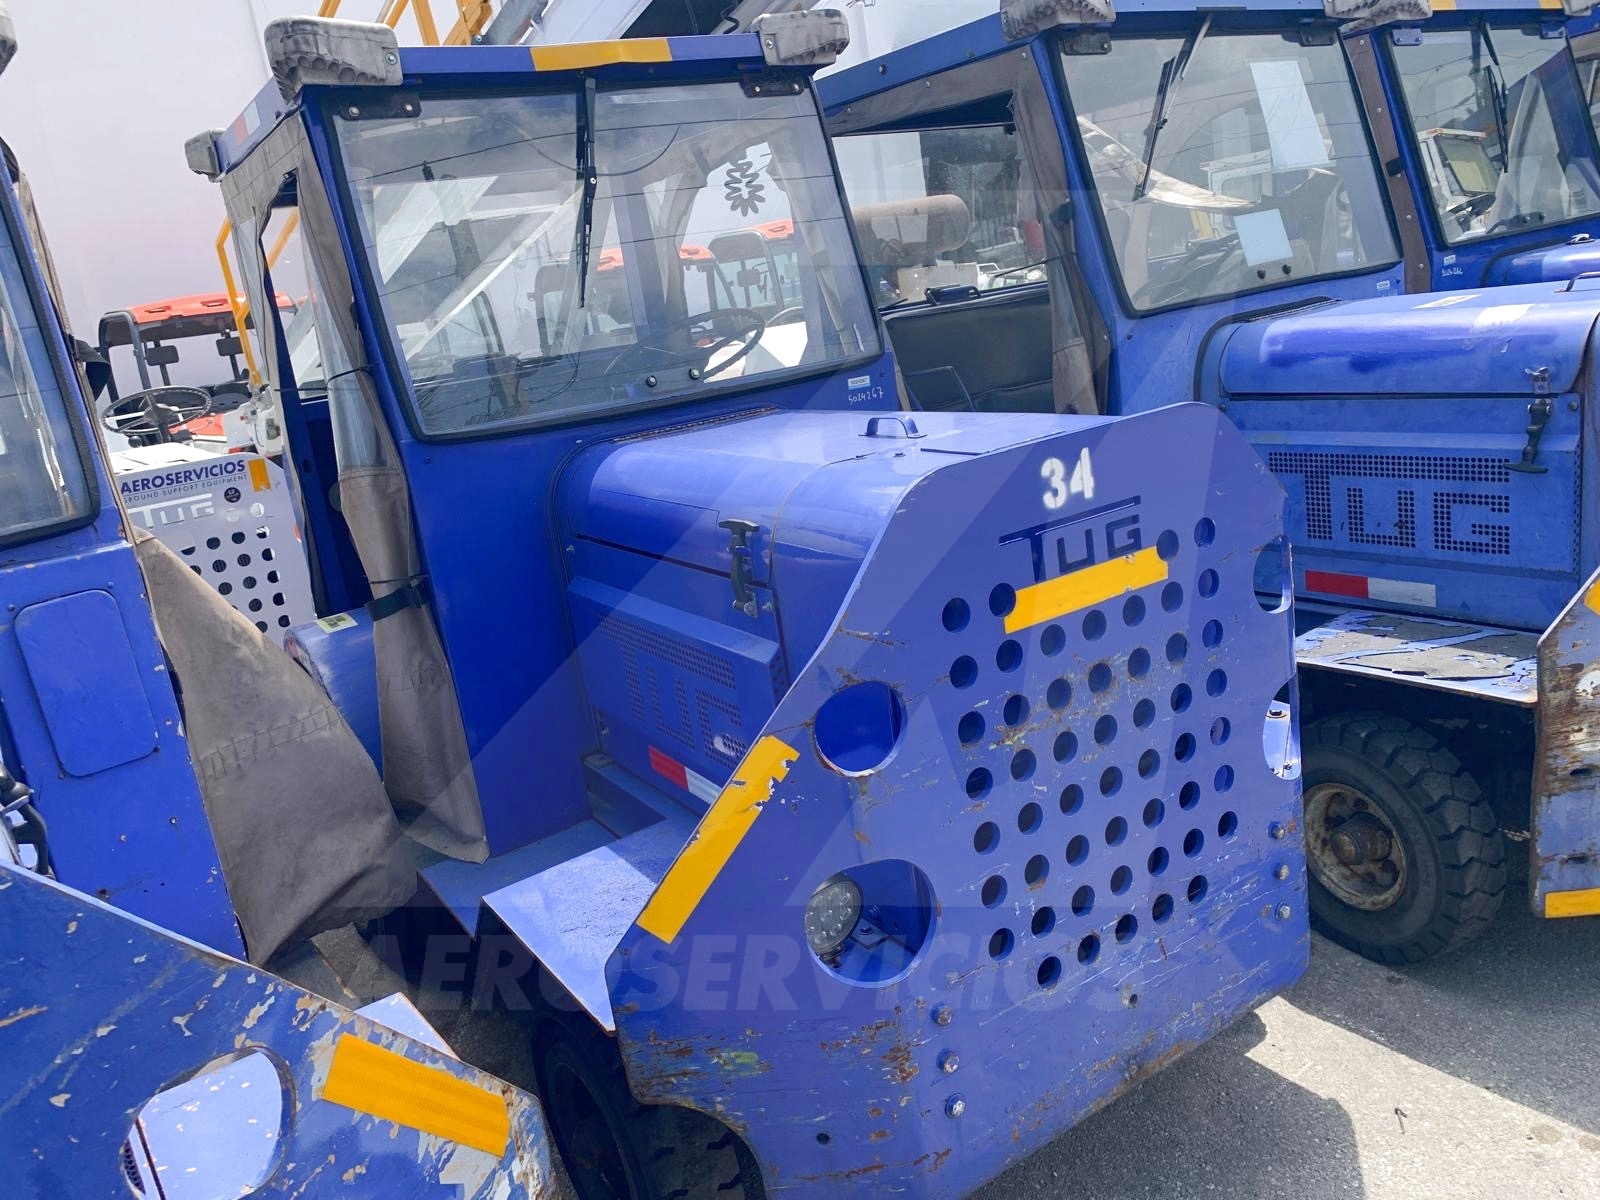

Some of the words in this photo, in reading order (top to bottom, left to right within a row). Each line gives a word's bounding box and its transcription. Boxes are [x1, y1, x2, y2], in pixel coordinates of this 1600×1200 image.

[121, 459, 246, 495] AEROSERVICIOS
[163, 483, 199, 497] SUPPORT
[202, 474, 247, 488] EQUIPMENT
[1041, 447, 1095, 509] 34
[128, 493, 215, 529] TUG
[1269, 452, 1510, 555] TUG
[999, 495, 1142, 583] TUG
